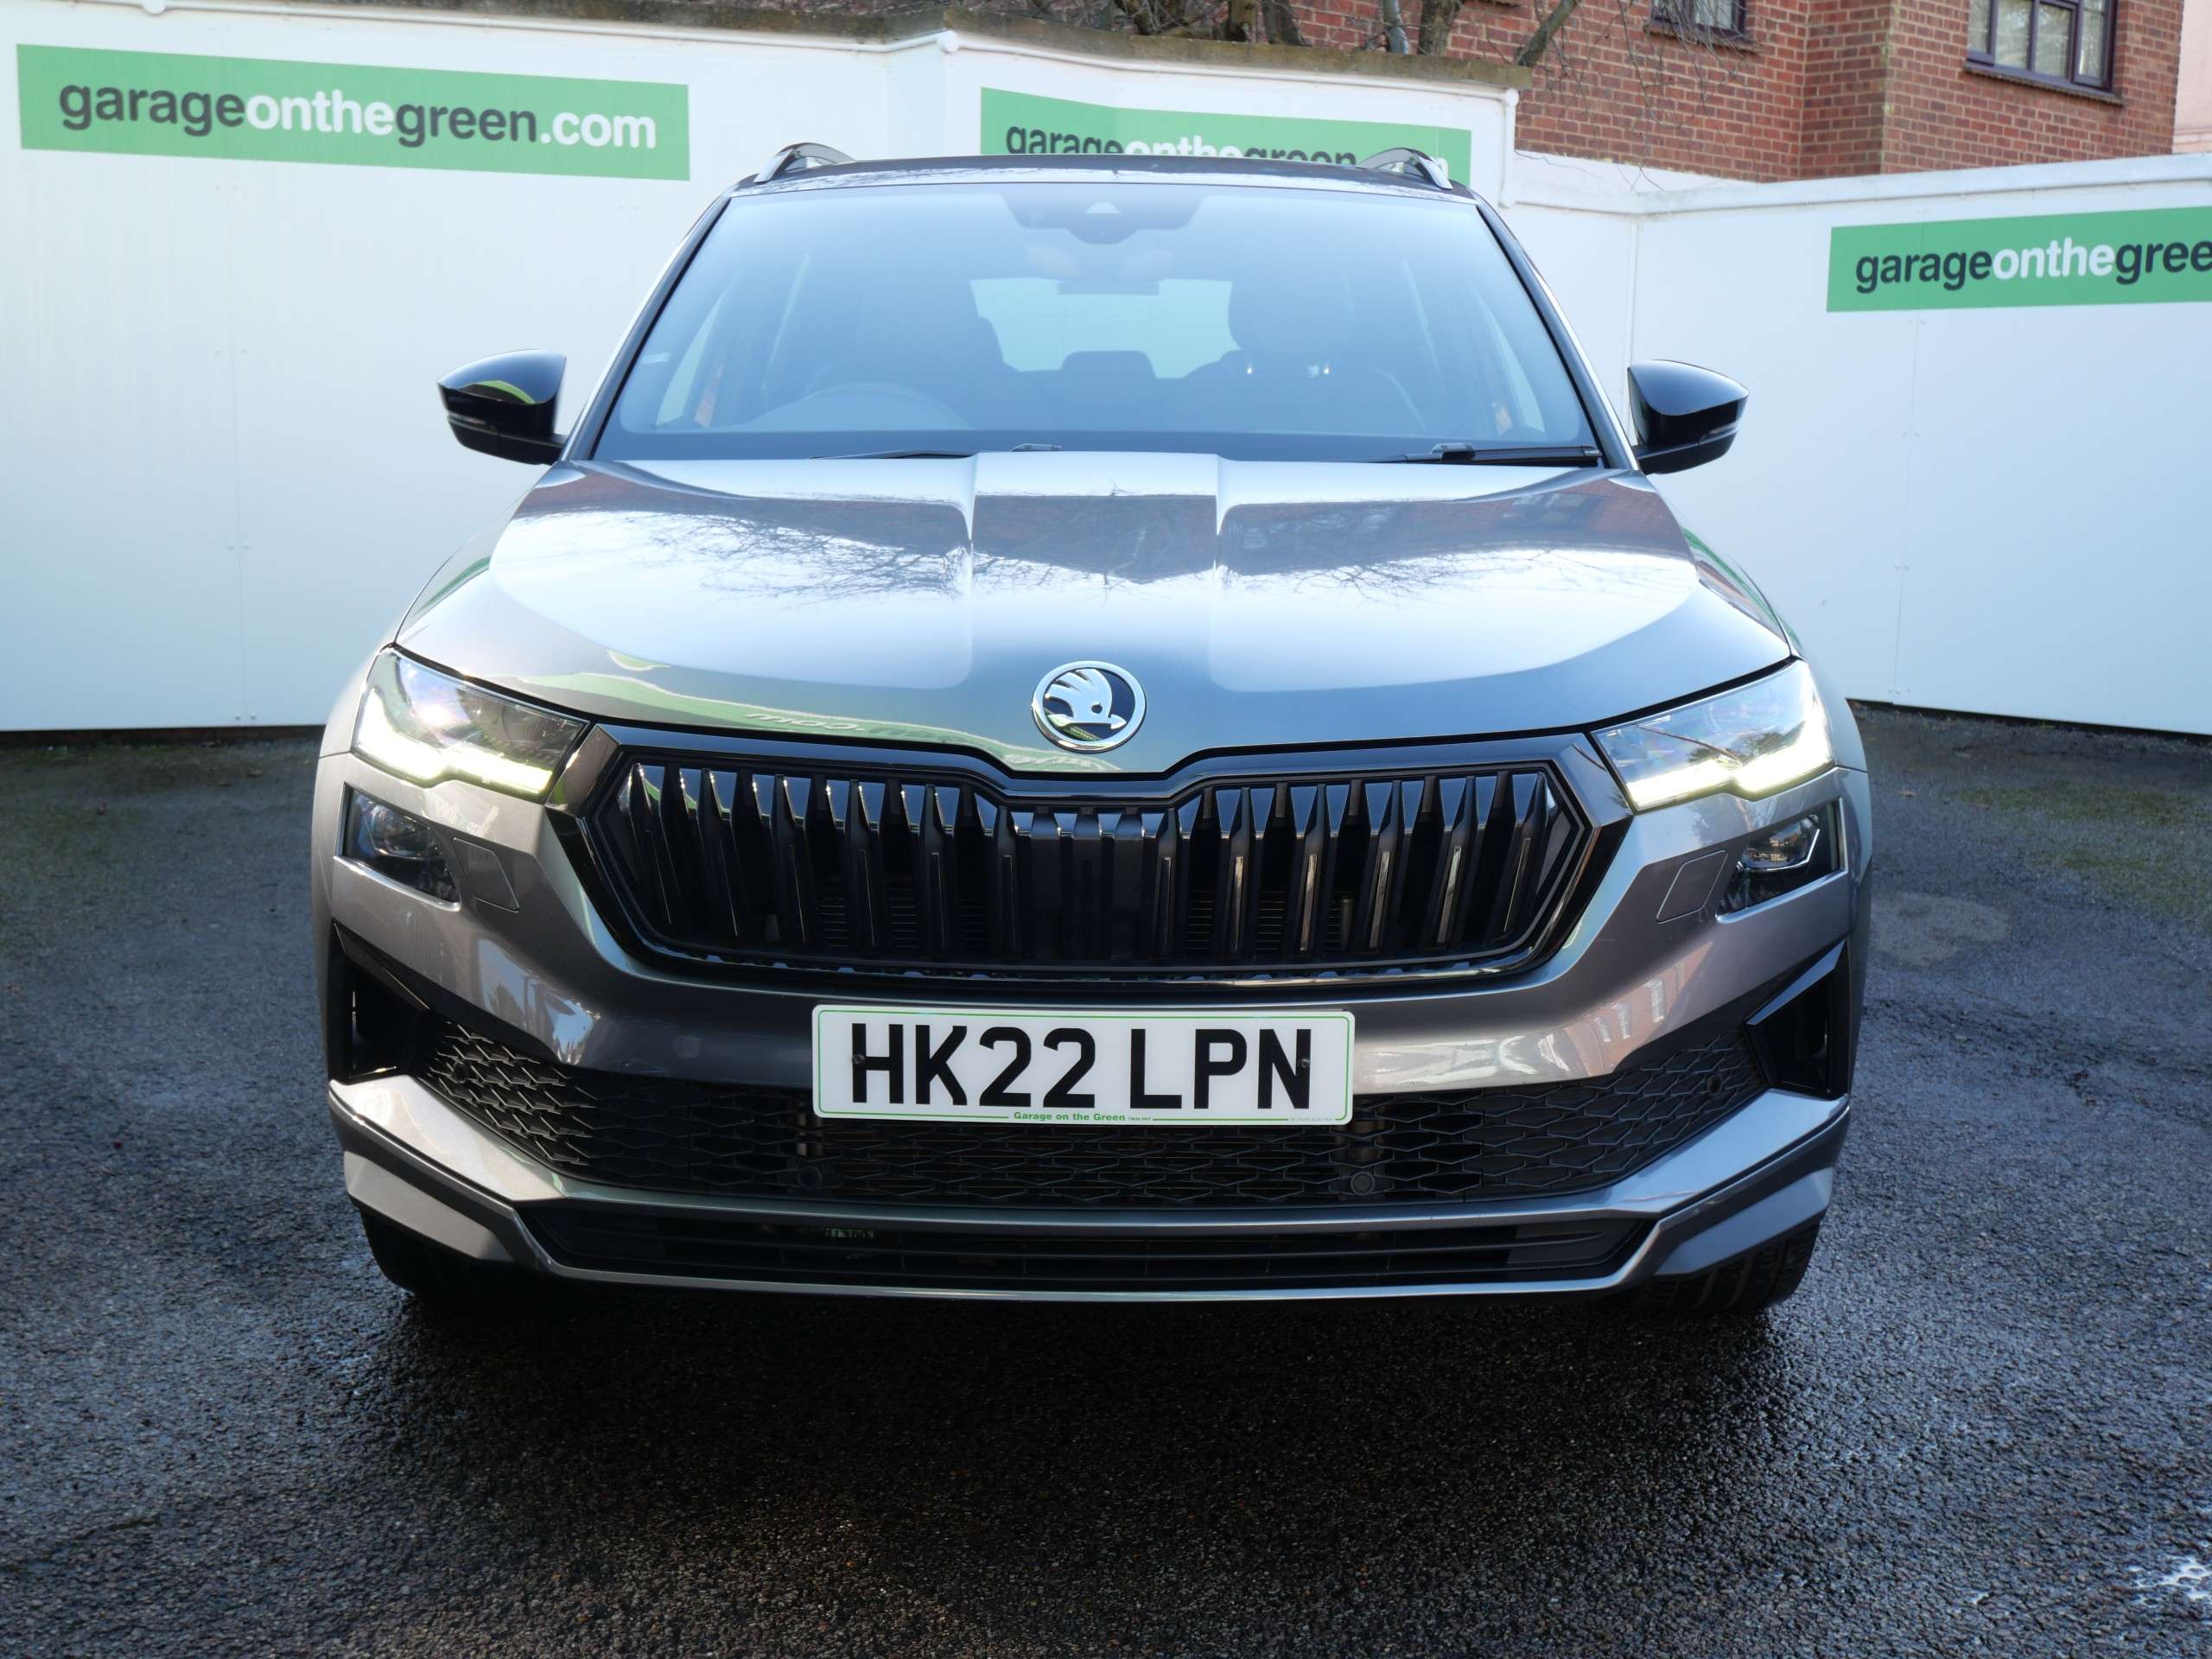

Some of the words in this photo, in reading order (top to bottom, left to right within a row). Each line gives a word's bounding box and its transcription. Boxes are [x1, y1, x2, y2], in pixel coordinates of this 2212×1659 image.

[59, 84, 657, 149] garageonthegreen.com
[851, 1023, 1096, 1109] HK22
[1129, 1028, 1312, 1110] LPN
[1013, 1111, 1052, 1122] Garage
[1072, 1112, 1090, 1121] the
[1093, 1113, 1126, 1122] Green
